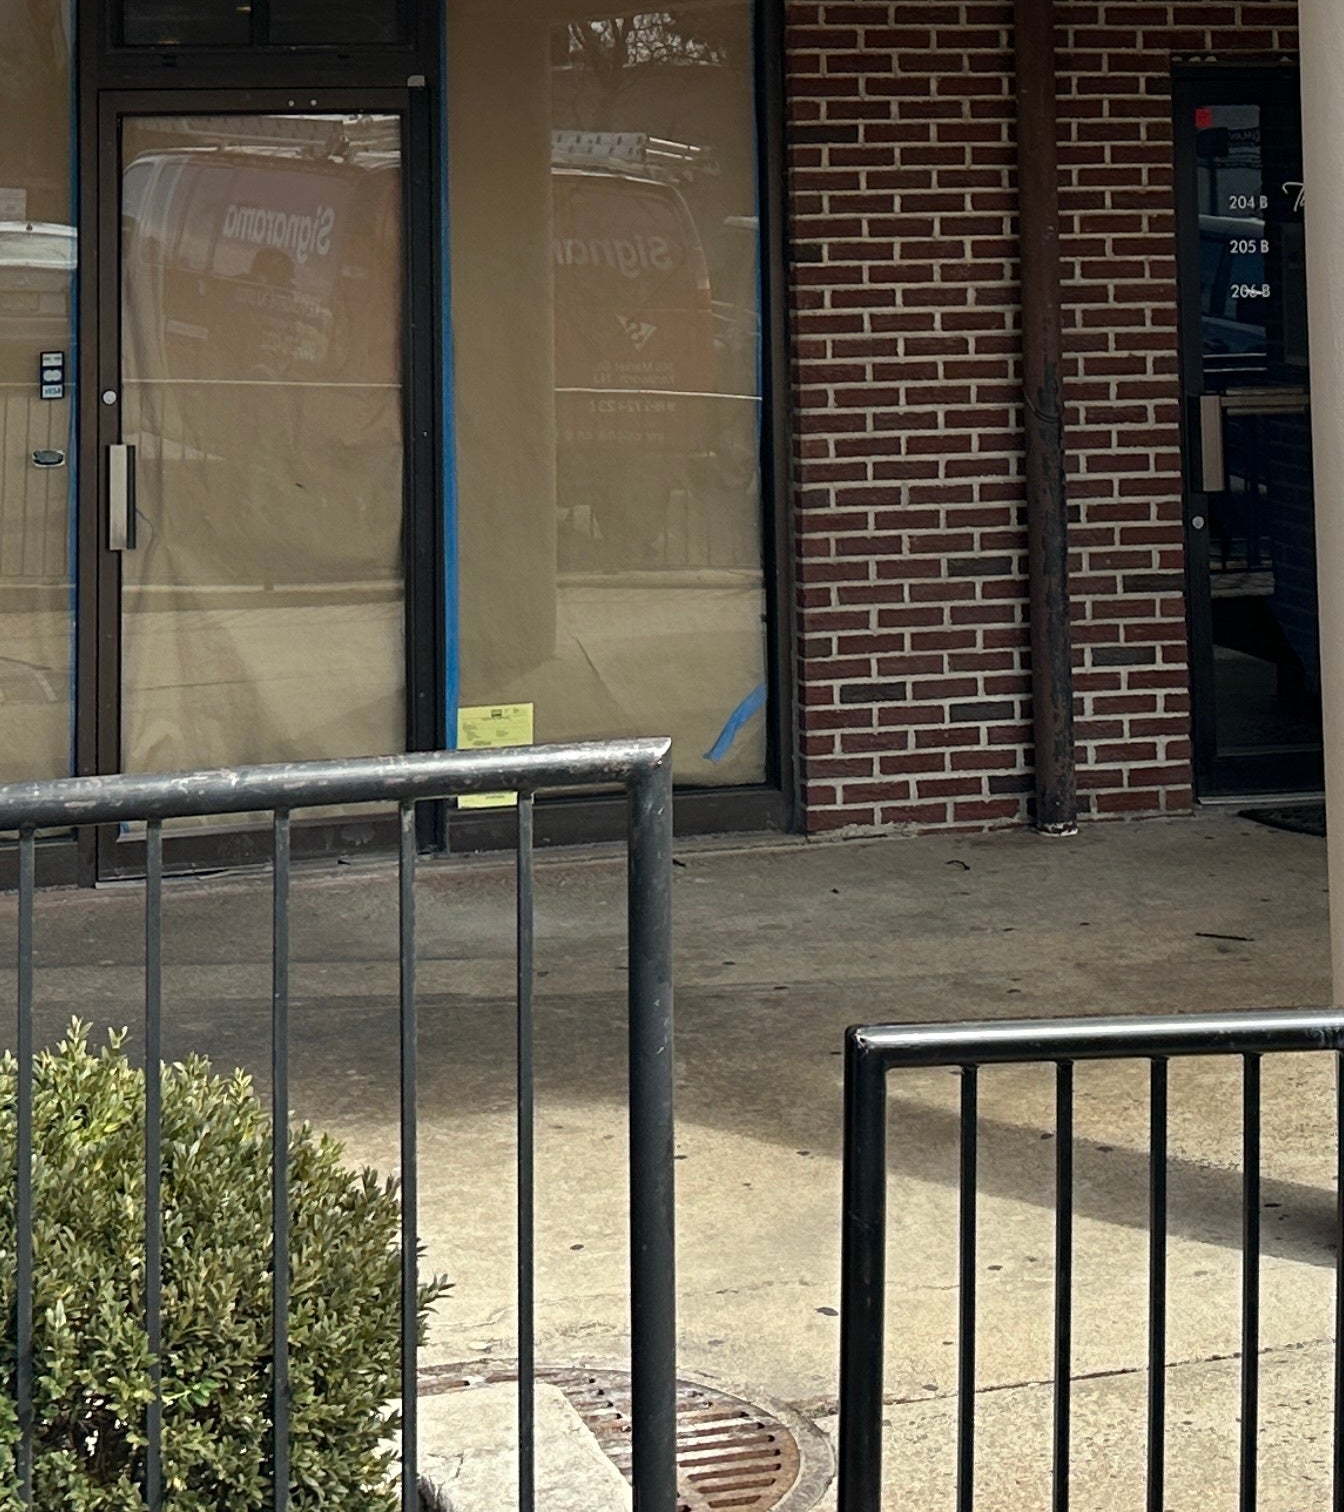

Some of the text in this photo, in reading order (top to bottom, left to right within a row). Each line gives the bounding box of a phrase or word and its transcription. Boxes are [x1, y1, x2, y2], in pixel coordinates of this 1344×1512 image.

[1229, 195, 1268, 209] 204 B
[1229, 239, 1270, 254] 205 B
